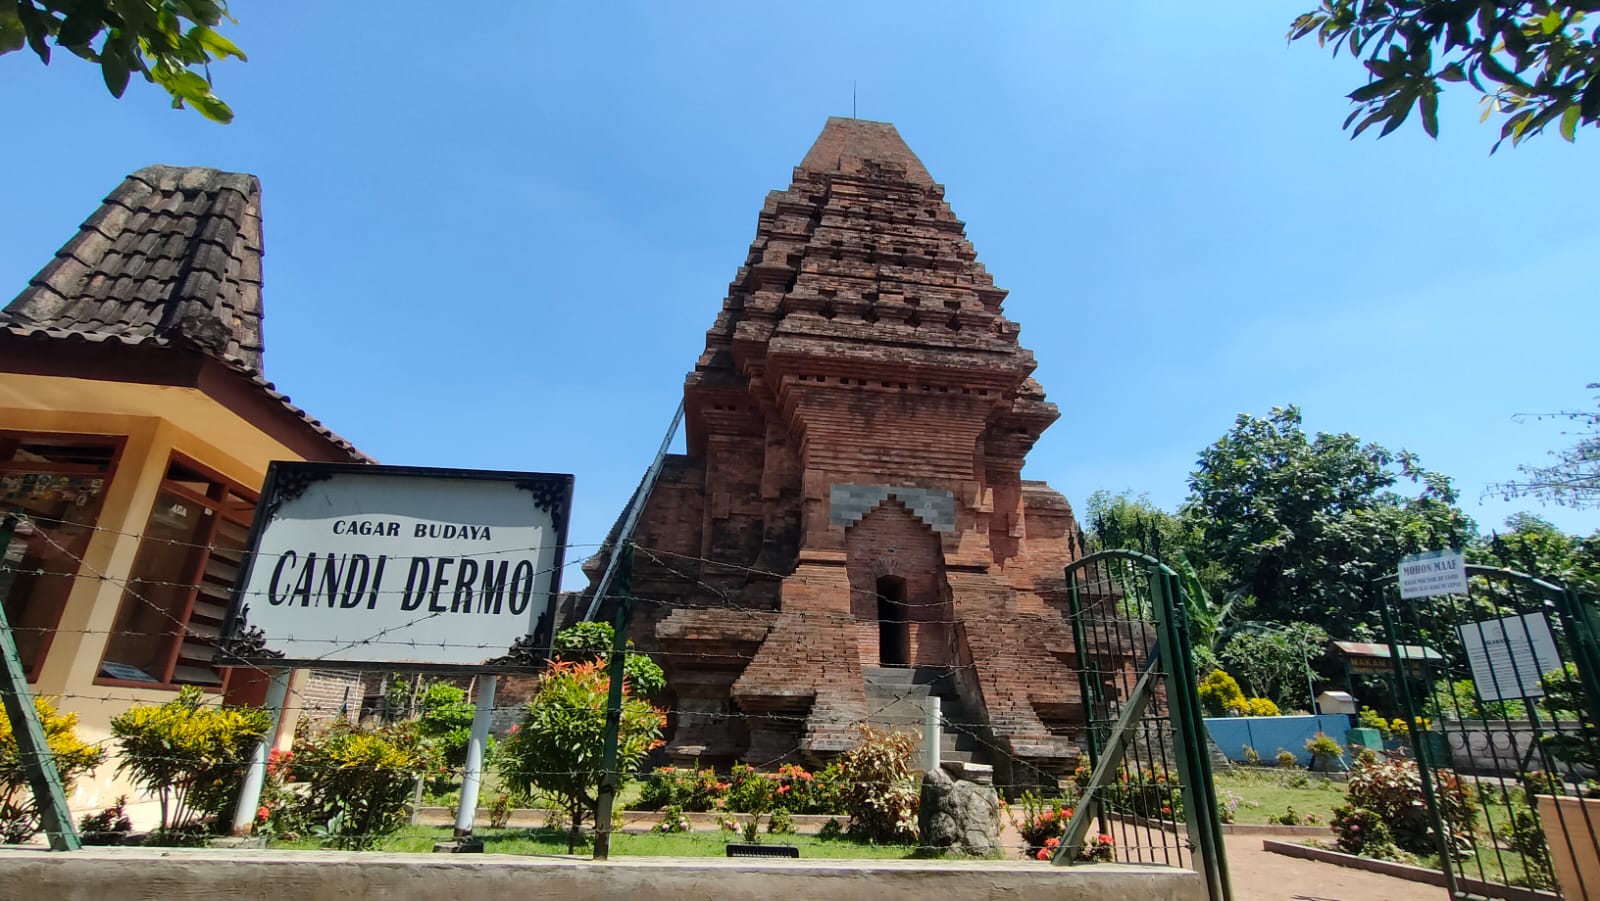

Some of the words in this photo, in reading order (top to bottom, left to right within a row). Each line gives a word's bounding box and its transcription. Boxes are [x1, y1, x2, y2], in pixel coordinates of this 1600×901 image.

[333, 520, 401, 537] CAGAR
[414, 523, 491, 541] BUDAYA
[1403, 563, 1432, 576] MOHON
[1434, 560, 1457, 572] MAAF
[268, 549, 387, 610] CANDI
[400, 556, 534, 616] DERMO
